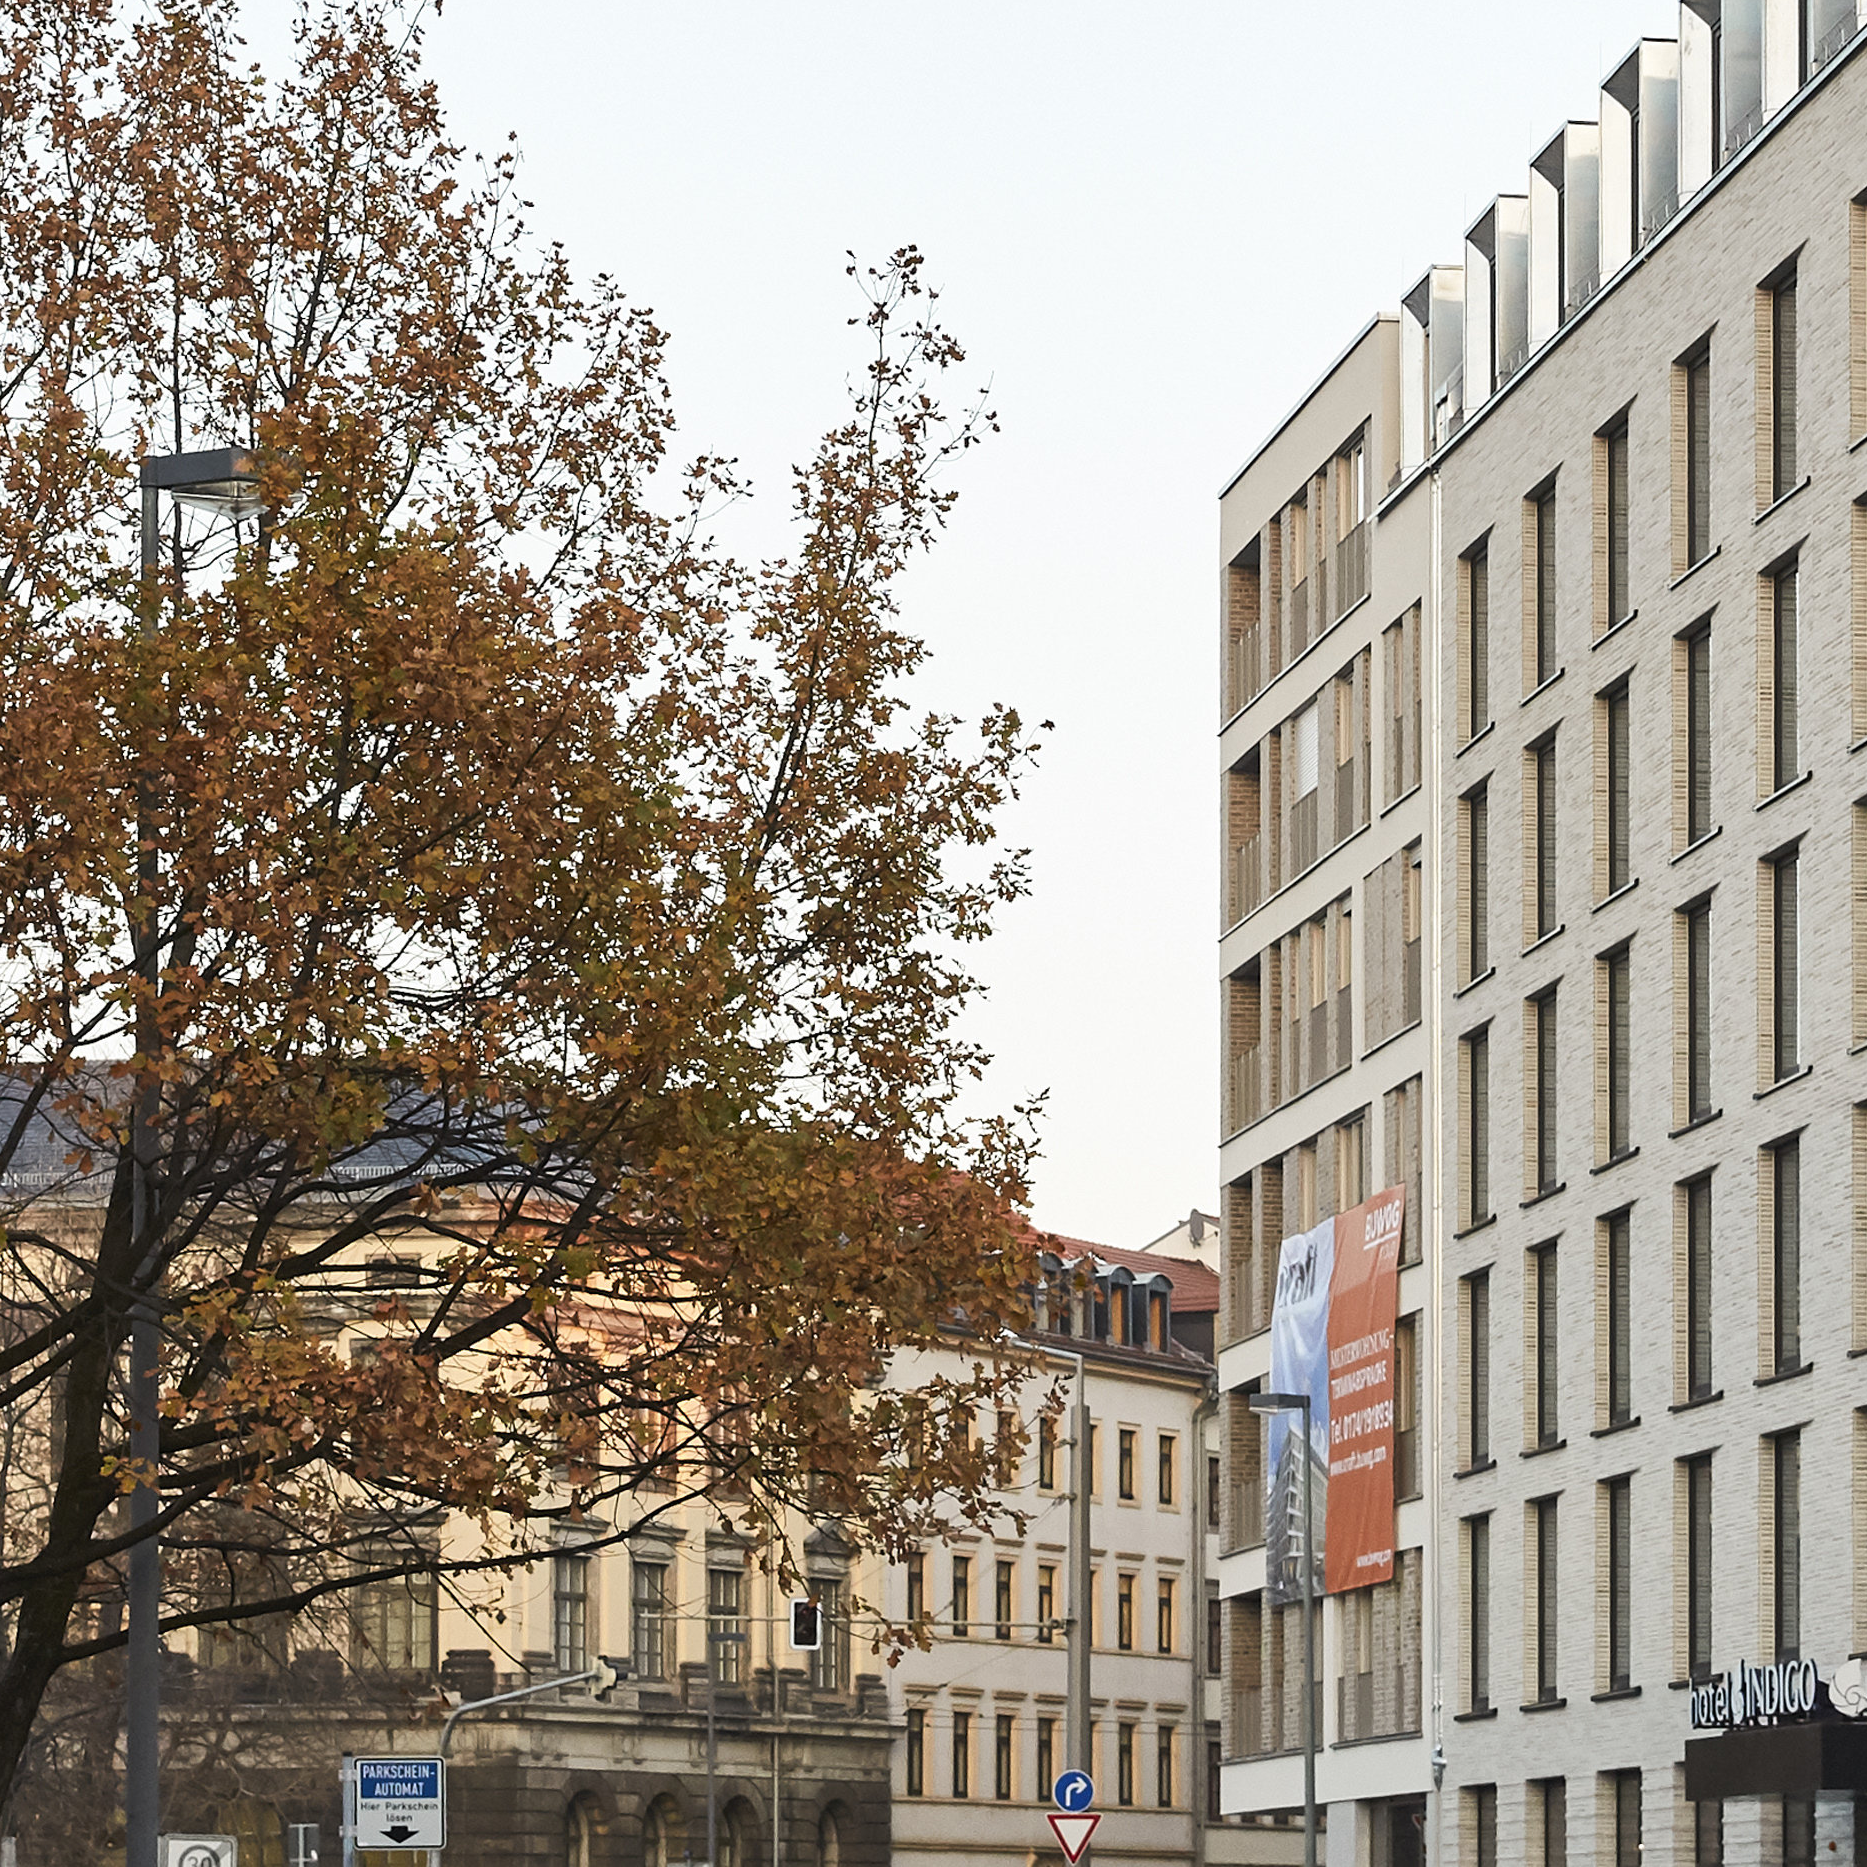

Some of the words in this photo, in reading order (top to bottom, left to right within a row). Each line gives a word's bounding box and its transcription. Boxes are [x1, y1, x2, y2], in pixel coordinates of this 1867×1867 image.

[1364, 1199, 1401, 1242] BUWOG
[1689, 1671, 1731, 1727] hotel
[1744, 1658, 1818, 1718] INDIGO
[362, 1764, 435, 1779] PARKSCHEIN-
[374, 1782, 424, 1796] AUTOMAT
[360, 1802, 380, 1811] Hier
[385, 1802, 438, 1811] Parkschein
[386, 1814, 413, 1822] lösen
